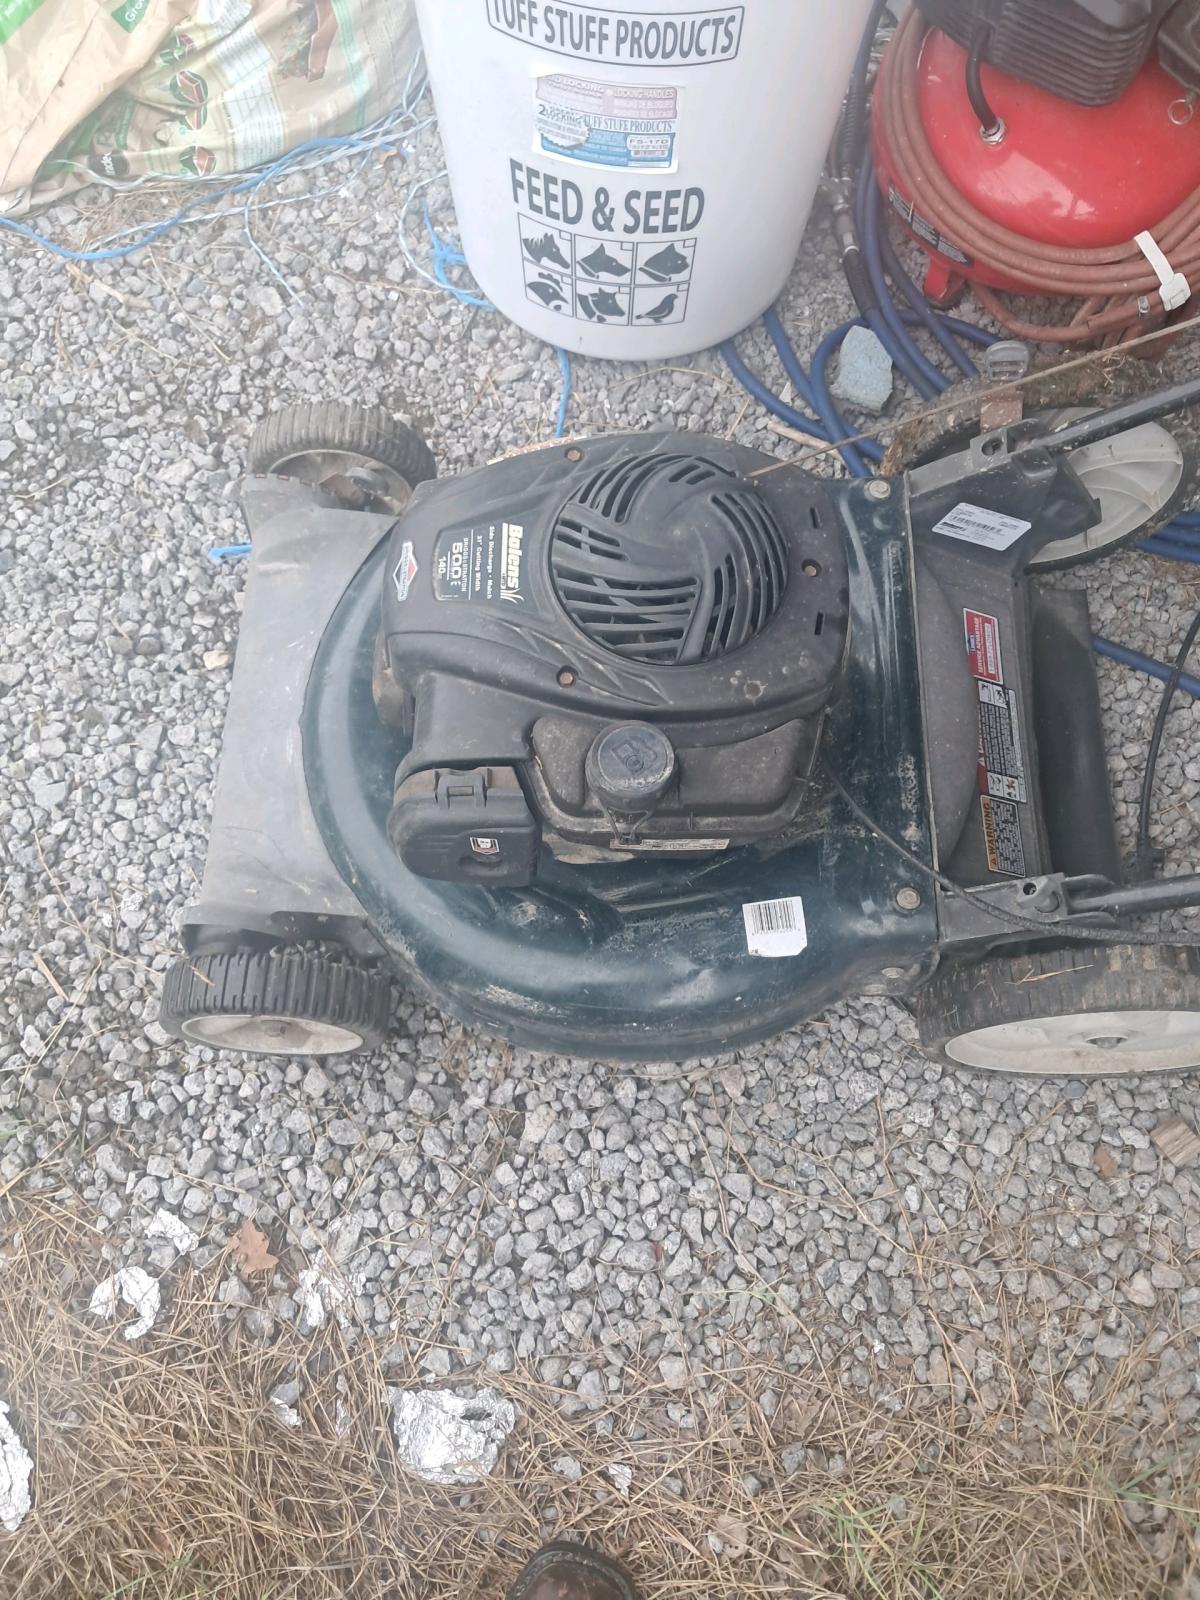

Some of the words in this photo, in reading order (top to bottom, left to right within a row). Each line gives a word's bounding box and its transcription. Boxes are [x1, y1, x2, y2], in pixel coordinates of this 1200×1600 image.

[543, 5, 609, 55] STUFF
[615, 14, 736, 60] PRODUCTS
[630, 120, 673, 133] PRODUCTS
[509, 157, 584, 226] FEED
[591, 186, 616, 233] &
[623, 186, 705, 235] SEED
[474, 547, 483, 571] Cutting
[486, 541, 495, 573] Discharge
[508, 524, 523, 589] Bolens
[984, 802, 996, 856] WARNING
